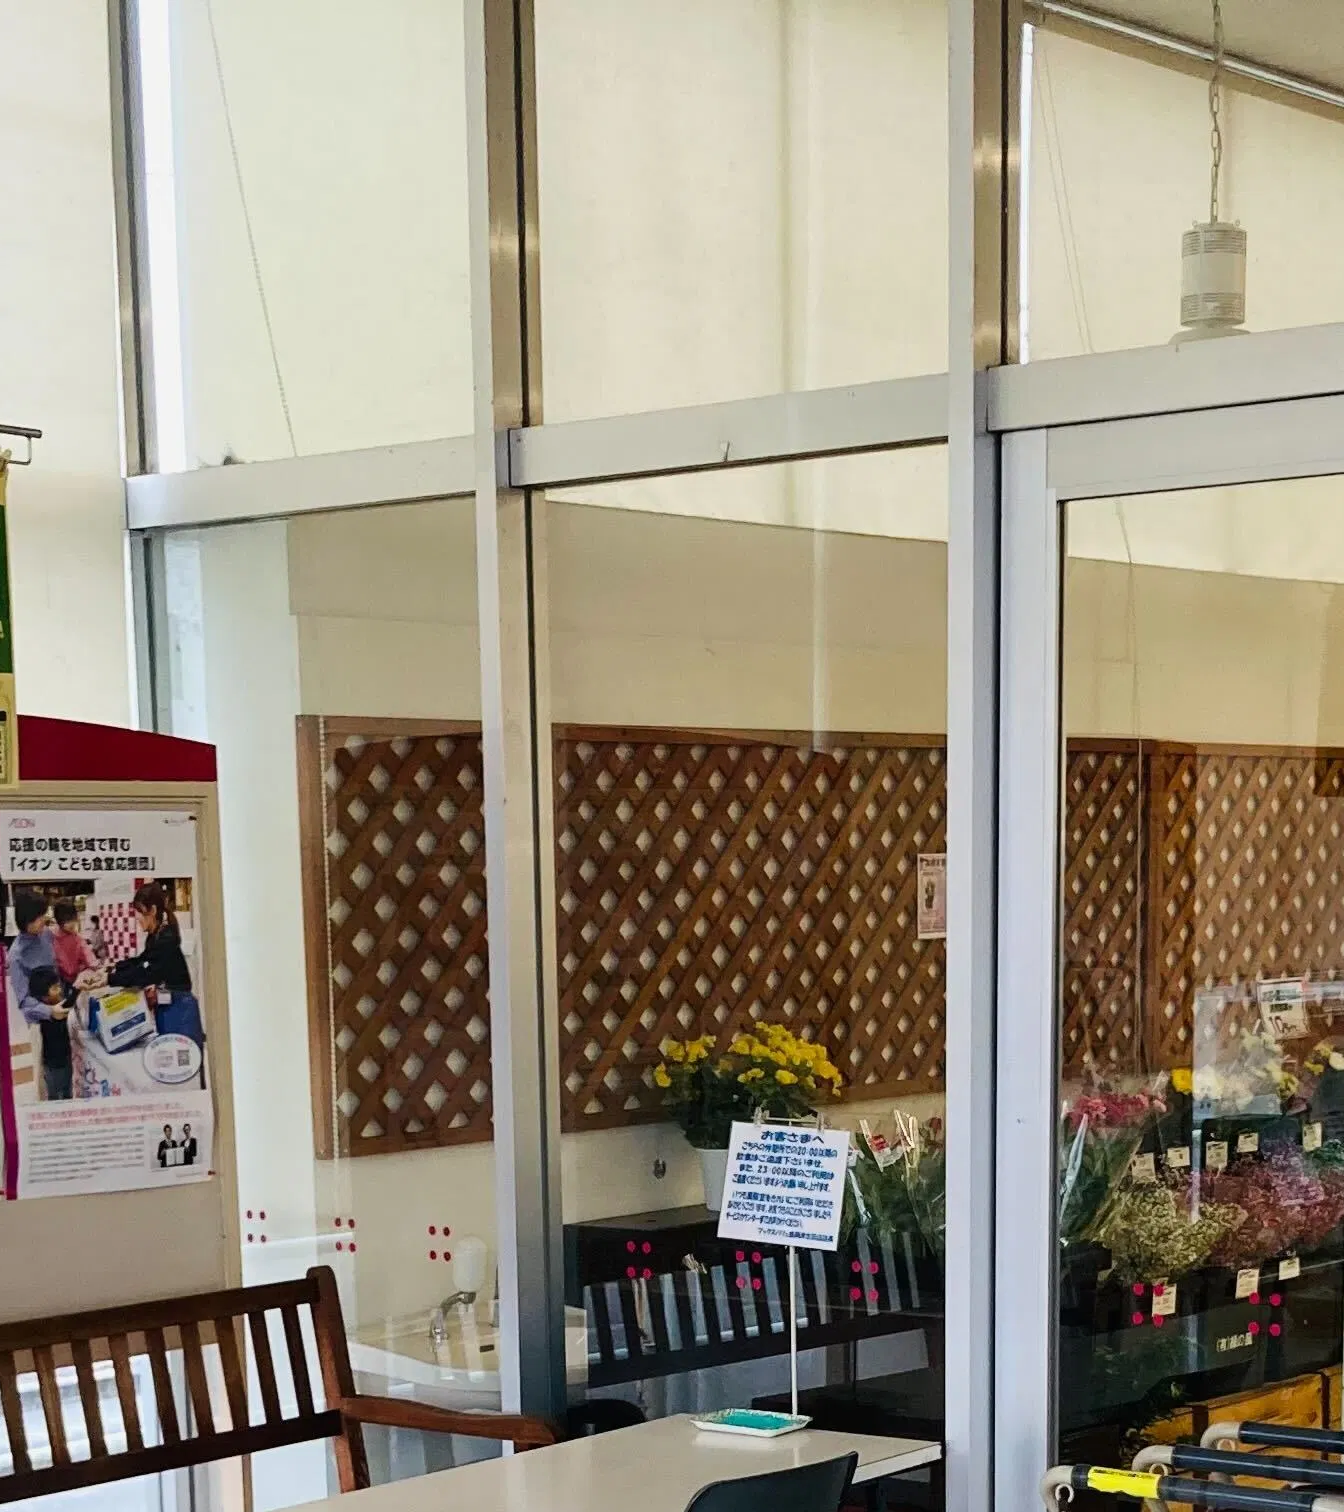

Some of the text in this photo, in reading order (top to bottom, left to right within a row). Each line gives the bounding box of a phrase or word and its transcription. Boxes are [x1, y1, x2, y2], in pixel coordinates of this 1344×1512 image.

[761, 1130, 824, 1144] お客さまへ
